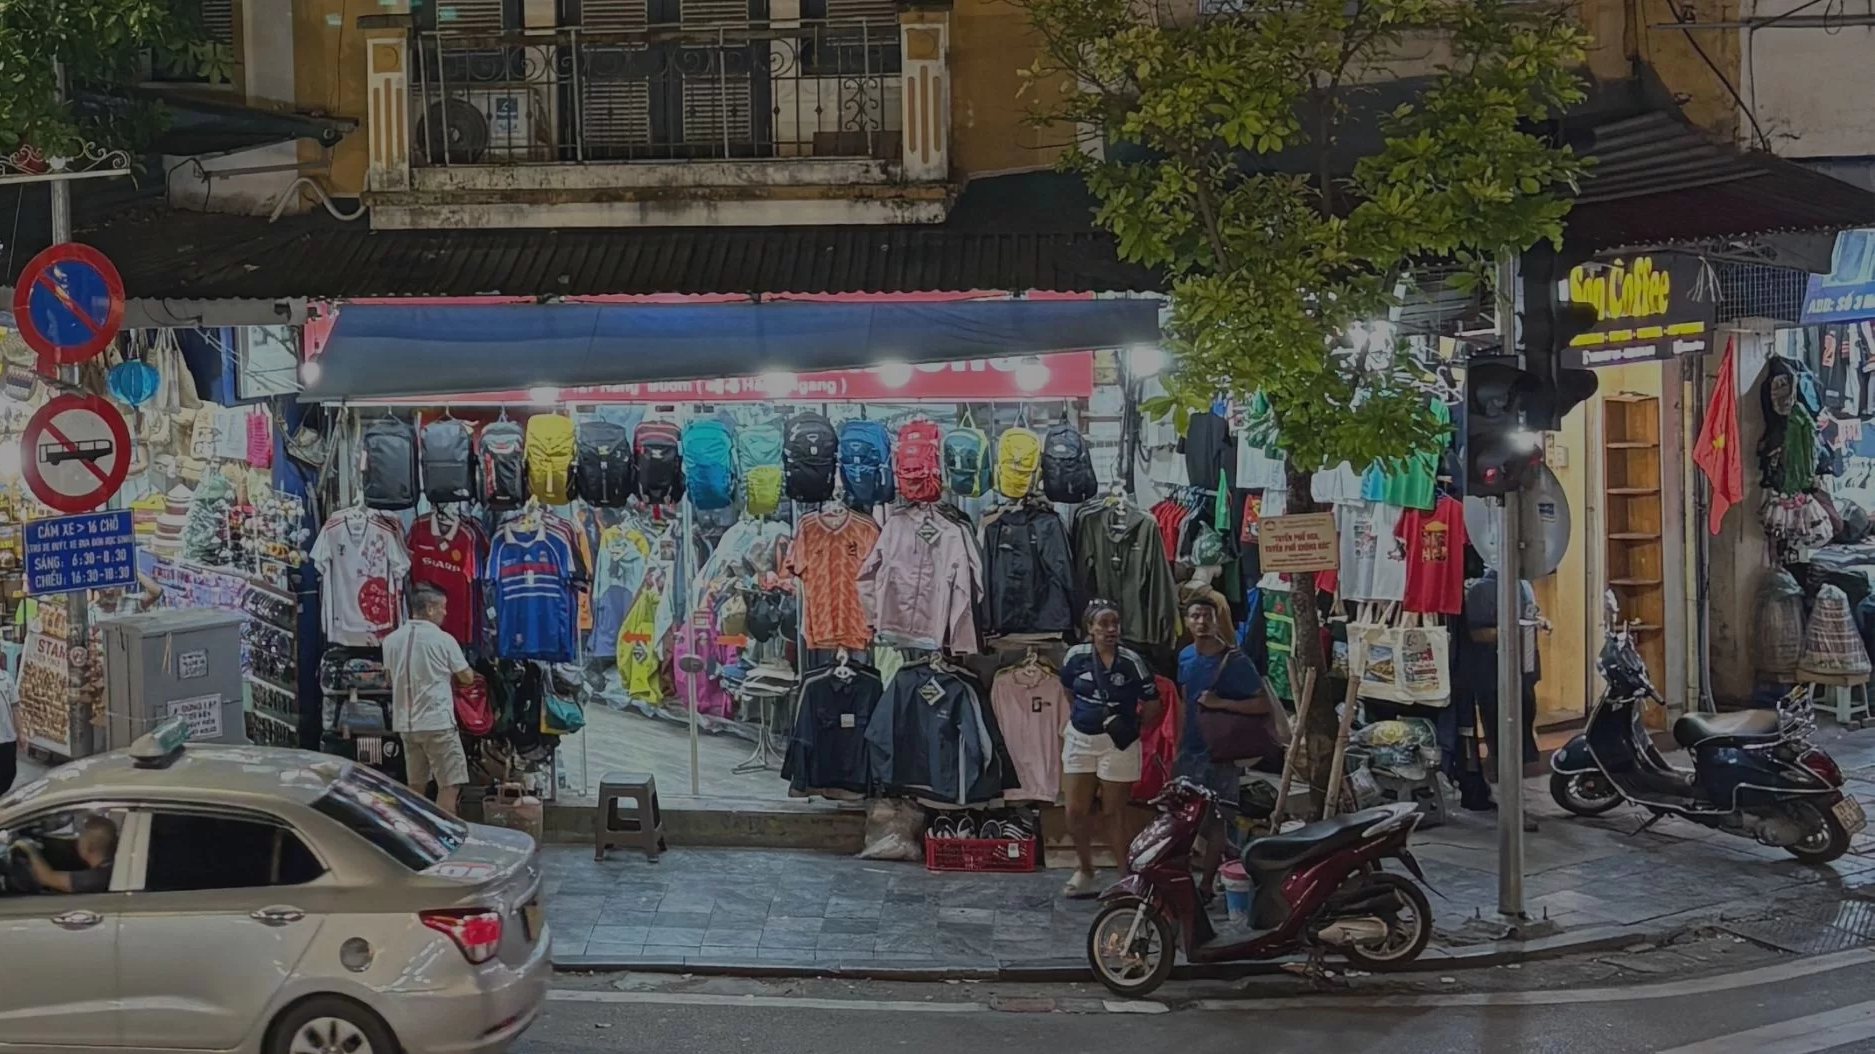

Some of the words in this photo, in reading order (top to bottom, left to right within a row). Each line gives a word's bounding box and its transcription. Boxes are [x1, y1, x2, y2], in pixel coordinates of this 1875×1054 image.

[37, 521, 59, 539] CẤM
[62, 522, 75, 536] XE
[87, 520, 98, 534] 16
[100, 514, 119, 533] CHỖ
[34, 553, 64, 571] SÁNG:
